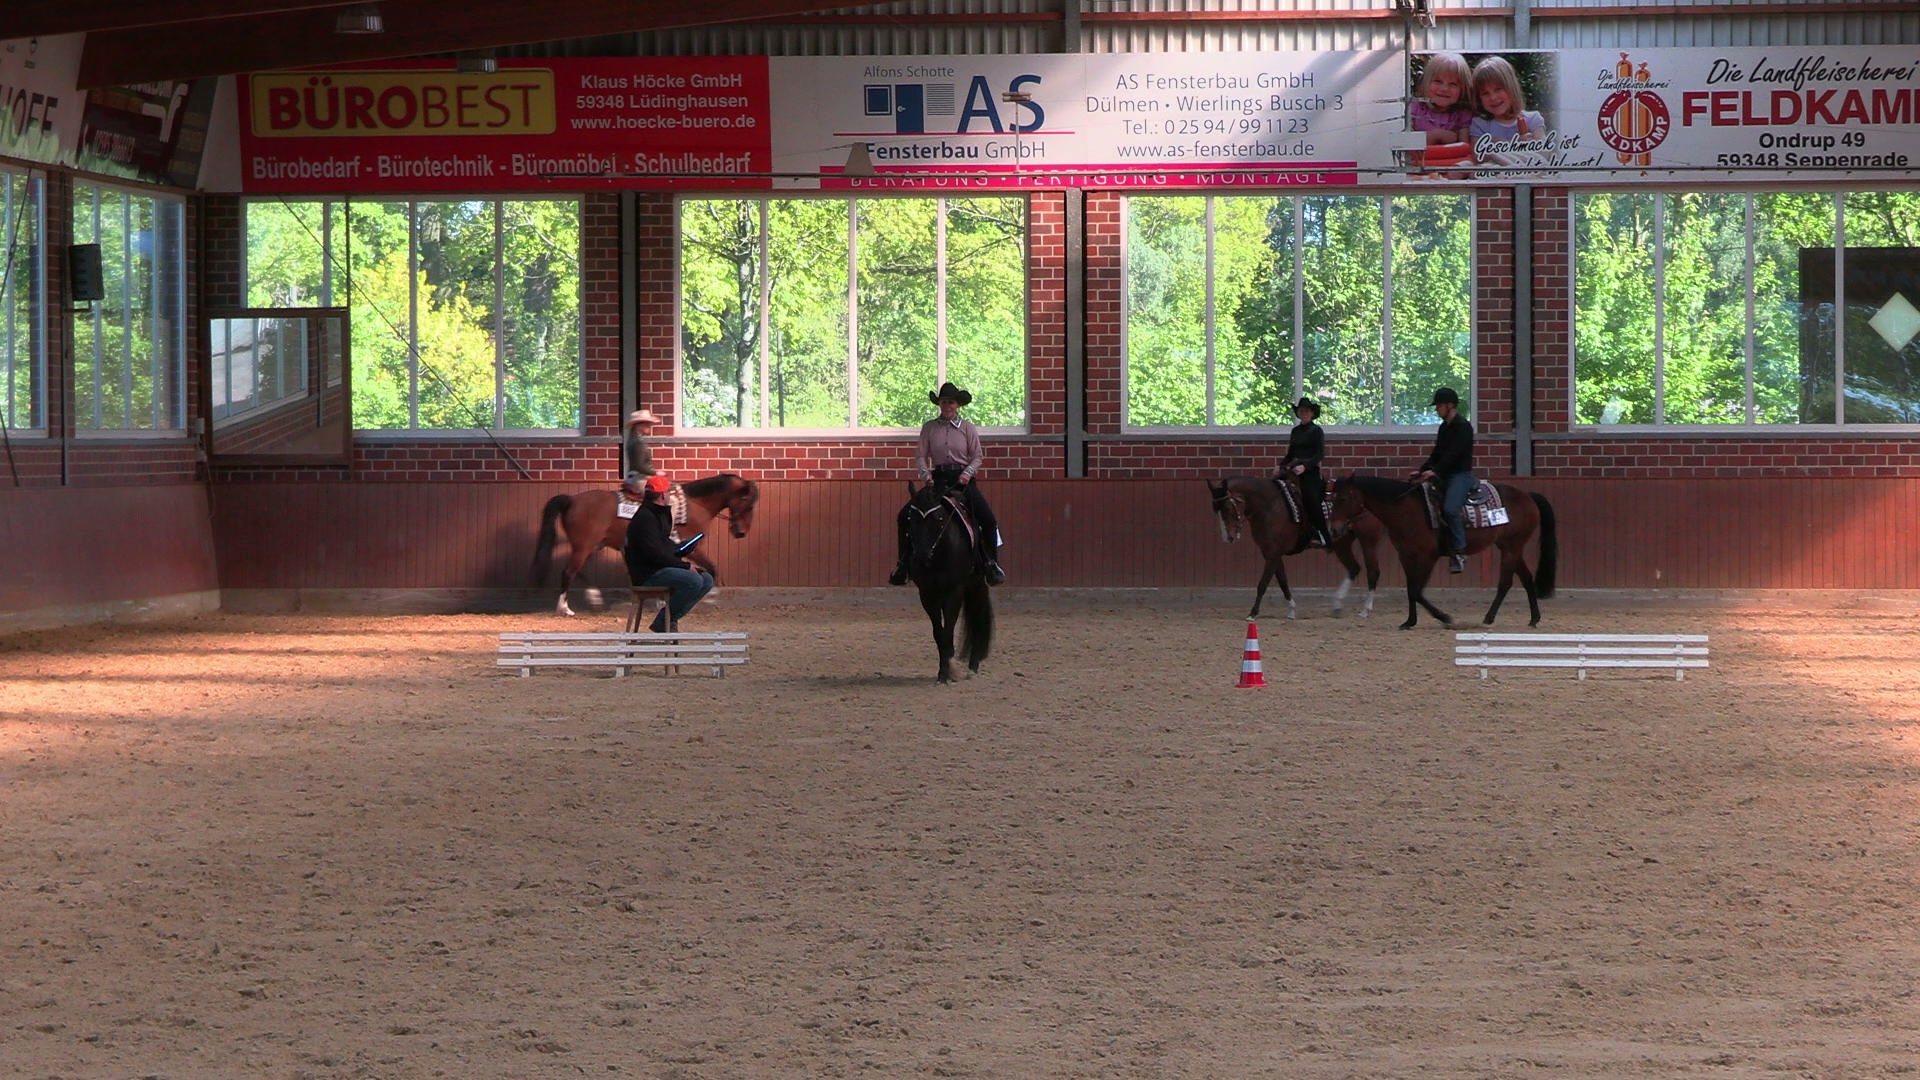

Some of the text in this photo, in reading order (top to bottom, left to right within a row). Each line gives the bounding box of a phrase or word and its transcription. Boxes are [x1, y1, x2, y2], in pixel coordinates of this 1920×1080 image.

[581, 74, 742, 88] Klaus Höcke GmbH
[864, 65, 954, 79] Alfons Schotte
[1115, 72, 1314, 89] AS Fensterbau GmbH
[1707, 56, 1920, 91] Die Landfleischerei
[269, 76, 540, 130] BÜROBEST
[576, 94, 748, 111] 59348 Lüdinghausen
[957, 74, 1045, 133] AS
[1086, 96, 1159, 113] Dülmen
[1177, 96, 1263, 115] Wierlings
[1271, 95, 1326, 111] Busch
[1334, 95, 1344, 110] 3
[571, 114, 756, 129] www.hoecke-buero.de
[1123, 119, 1158, 135] Tel.:
[1600, 116, 1668, 152] FELDKAMP
[1759, 132, 1865, 151] Ondrup 49
[867, 141, 1045, 159] Fensterbau GmbH
[1117, 140, 1314, 157] www.as-fensterbau.de
[1475, 132, 1579, 160] Geschmack ist
[252, 156, 360, 179] Bürobedarf
[378, 154, 493, 178] Bürotechnik
[635, 151, 751, 174] Schulbedarf
[1717, 153, 1908, 167] 59348 Seppenrade
